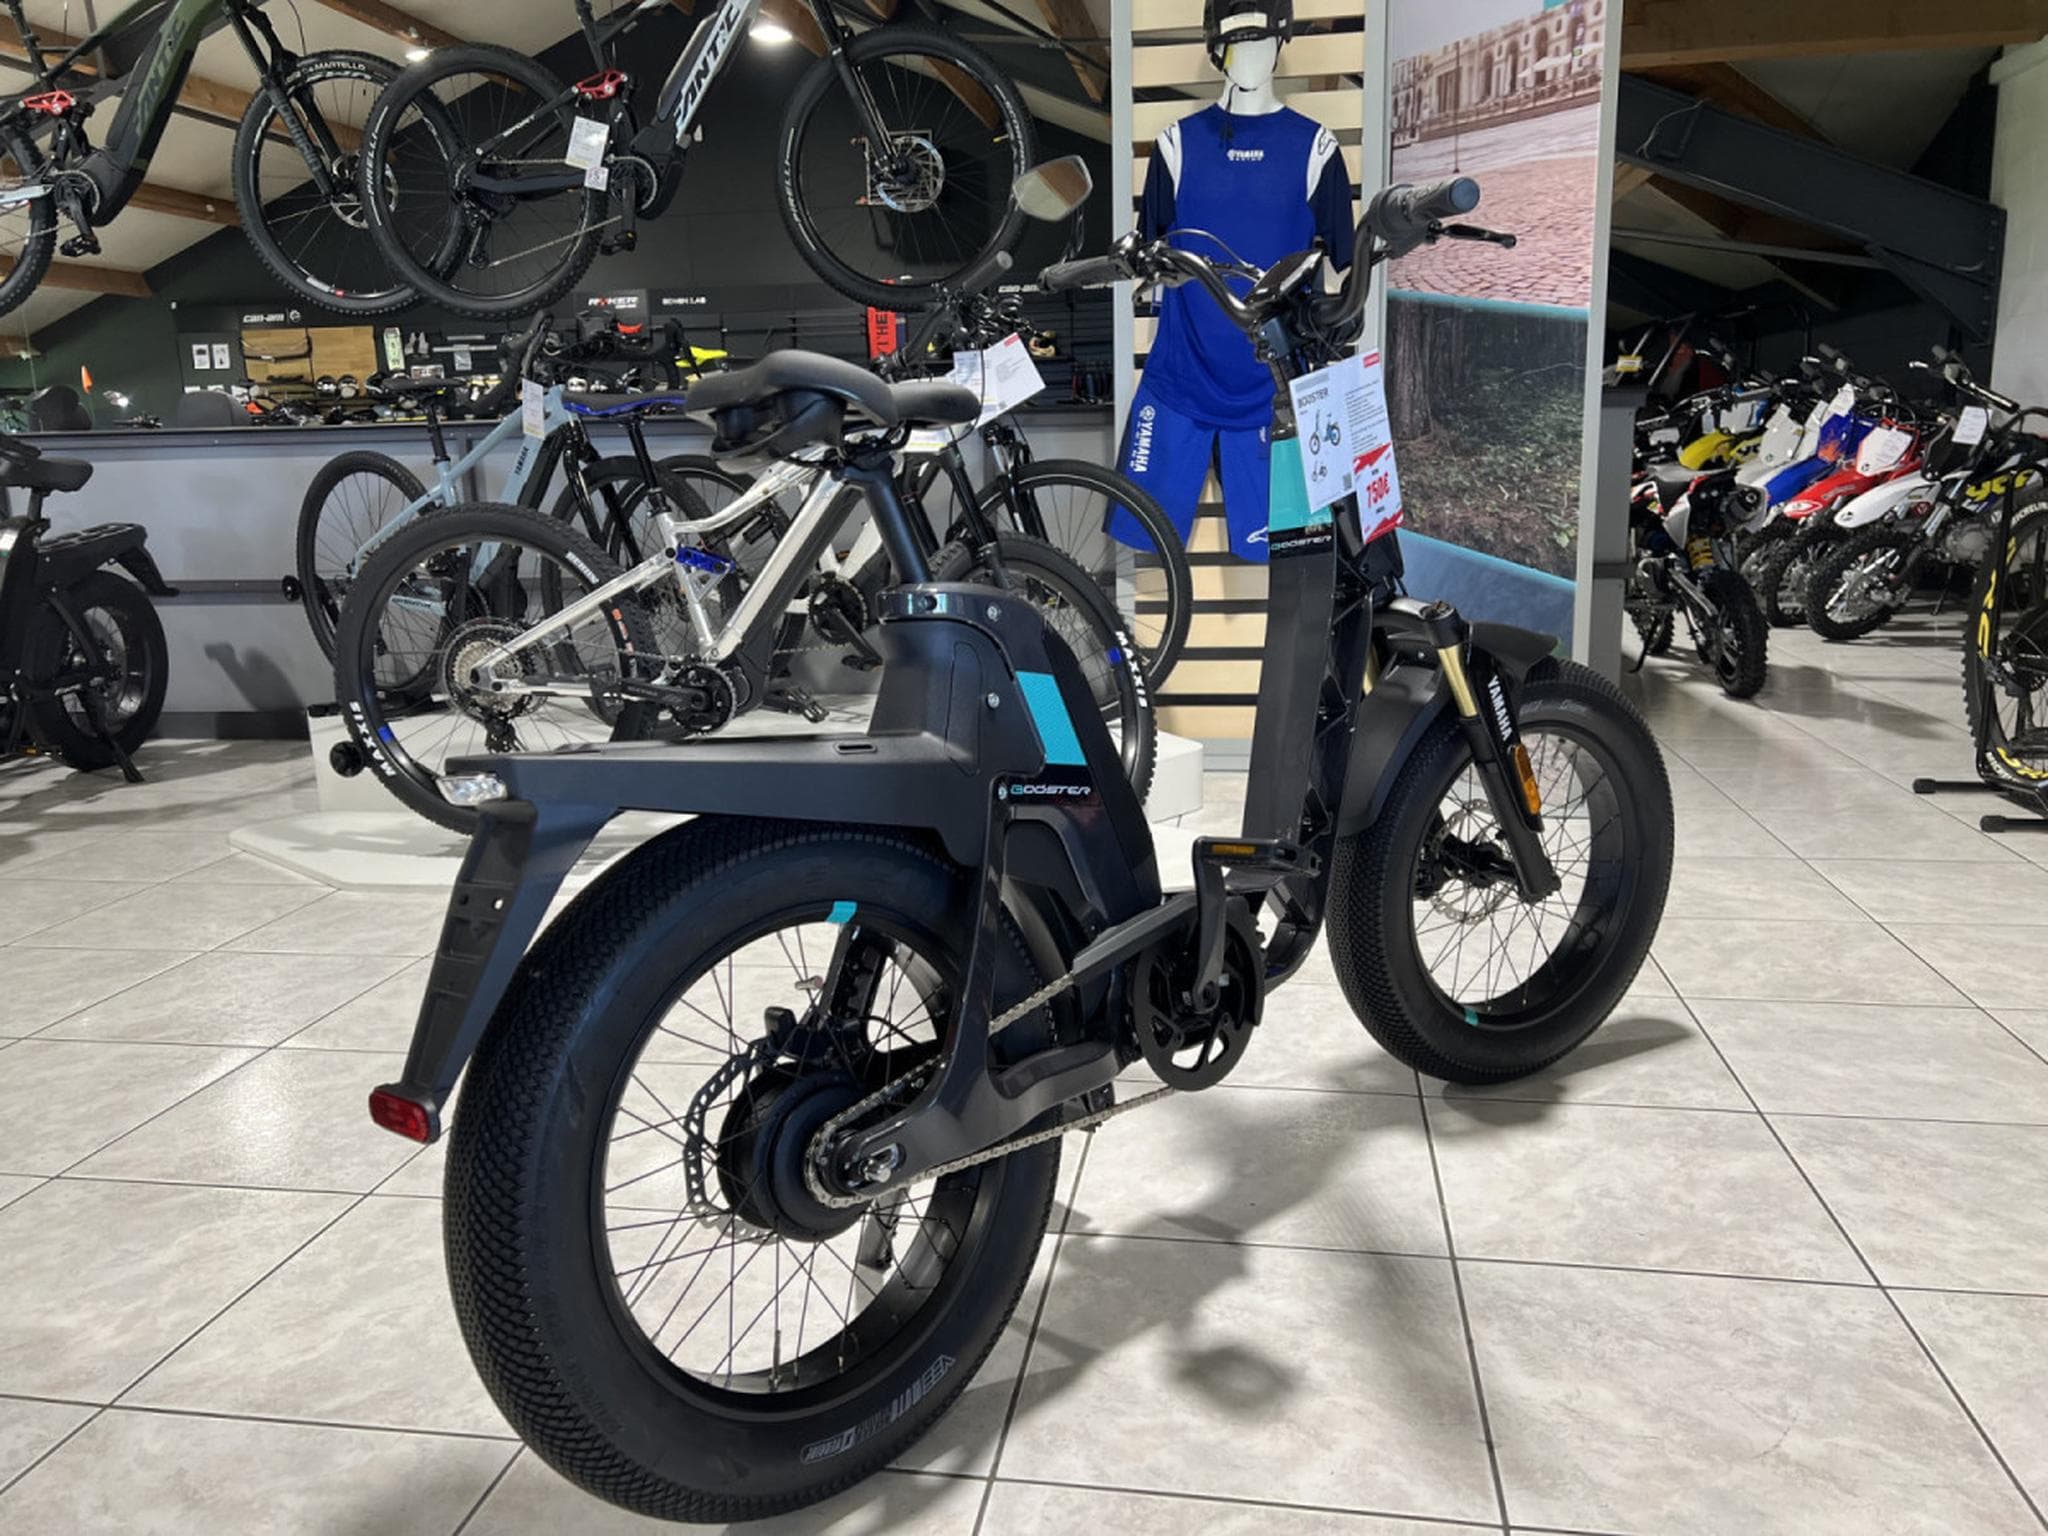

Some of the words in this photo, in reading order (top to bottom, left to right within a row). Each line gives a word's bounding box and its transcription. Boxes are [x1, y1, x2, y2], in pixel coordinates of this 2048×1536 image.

[313, 61, 366, 73] MARTELLO
[1132, 421, 1154, 473] YAMAHA
[1270, 535, 1332, 550] BOOSTER
[1115, 631, 1148, 708] MAXXIS
[1487, 674, 1513, 742] YAMAHA
[349, 701, 397, 776] MAXXIS
[1010, 784, 1092, 796] BOOSTER
